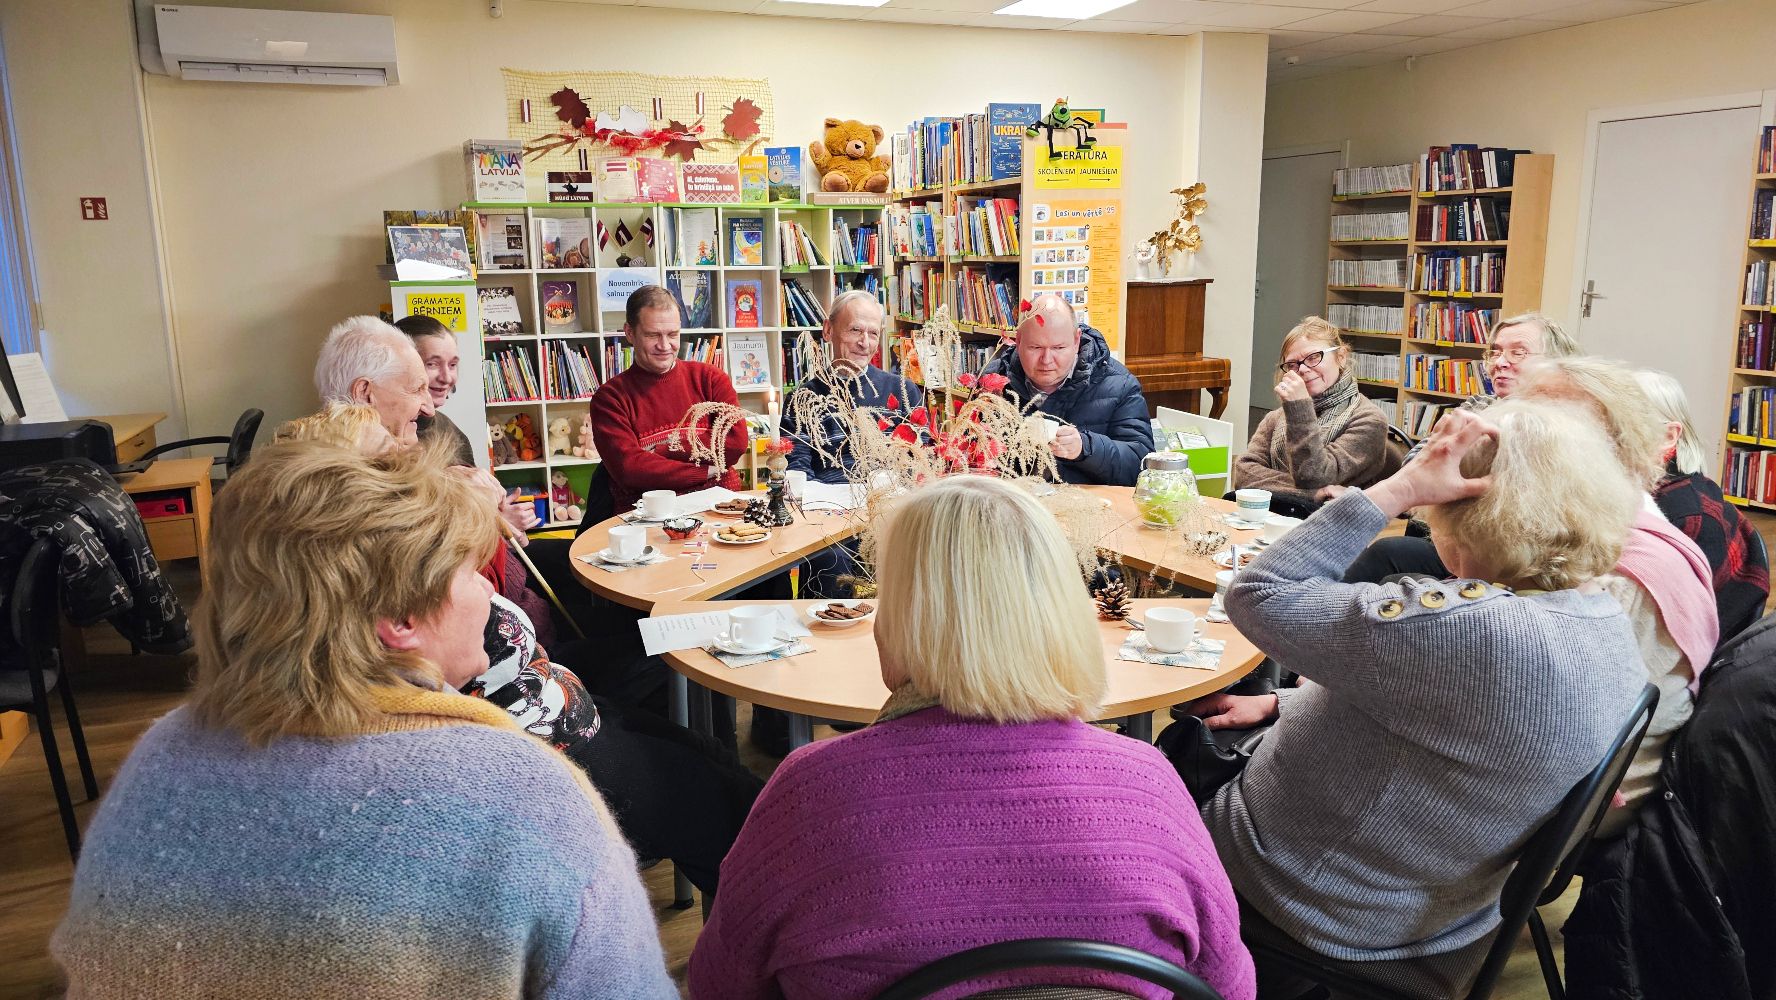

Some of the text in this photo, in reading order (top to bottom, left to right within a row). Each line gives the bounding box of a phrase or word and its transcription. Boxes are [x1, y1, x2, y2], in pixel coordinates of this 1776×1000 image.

[479, 151, 521, 169] MANA
[481, 168, 520, 176] LATVIJA
[1038, 166, 1118, 174] SKOLĒNIEM JAUNIEŠIEM
[1055, 209, 1070, 218] Lasi
[1082, 207, 1103, 218] vērtē
[411, 296, 461, 305] GRĀMATAS
[413, 305, 462, 316] BĒRNIEM
